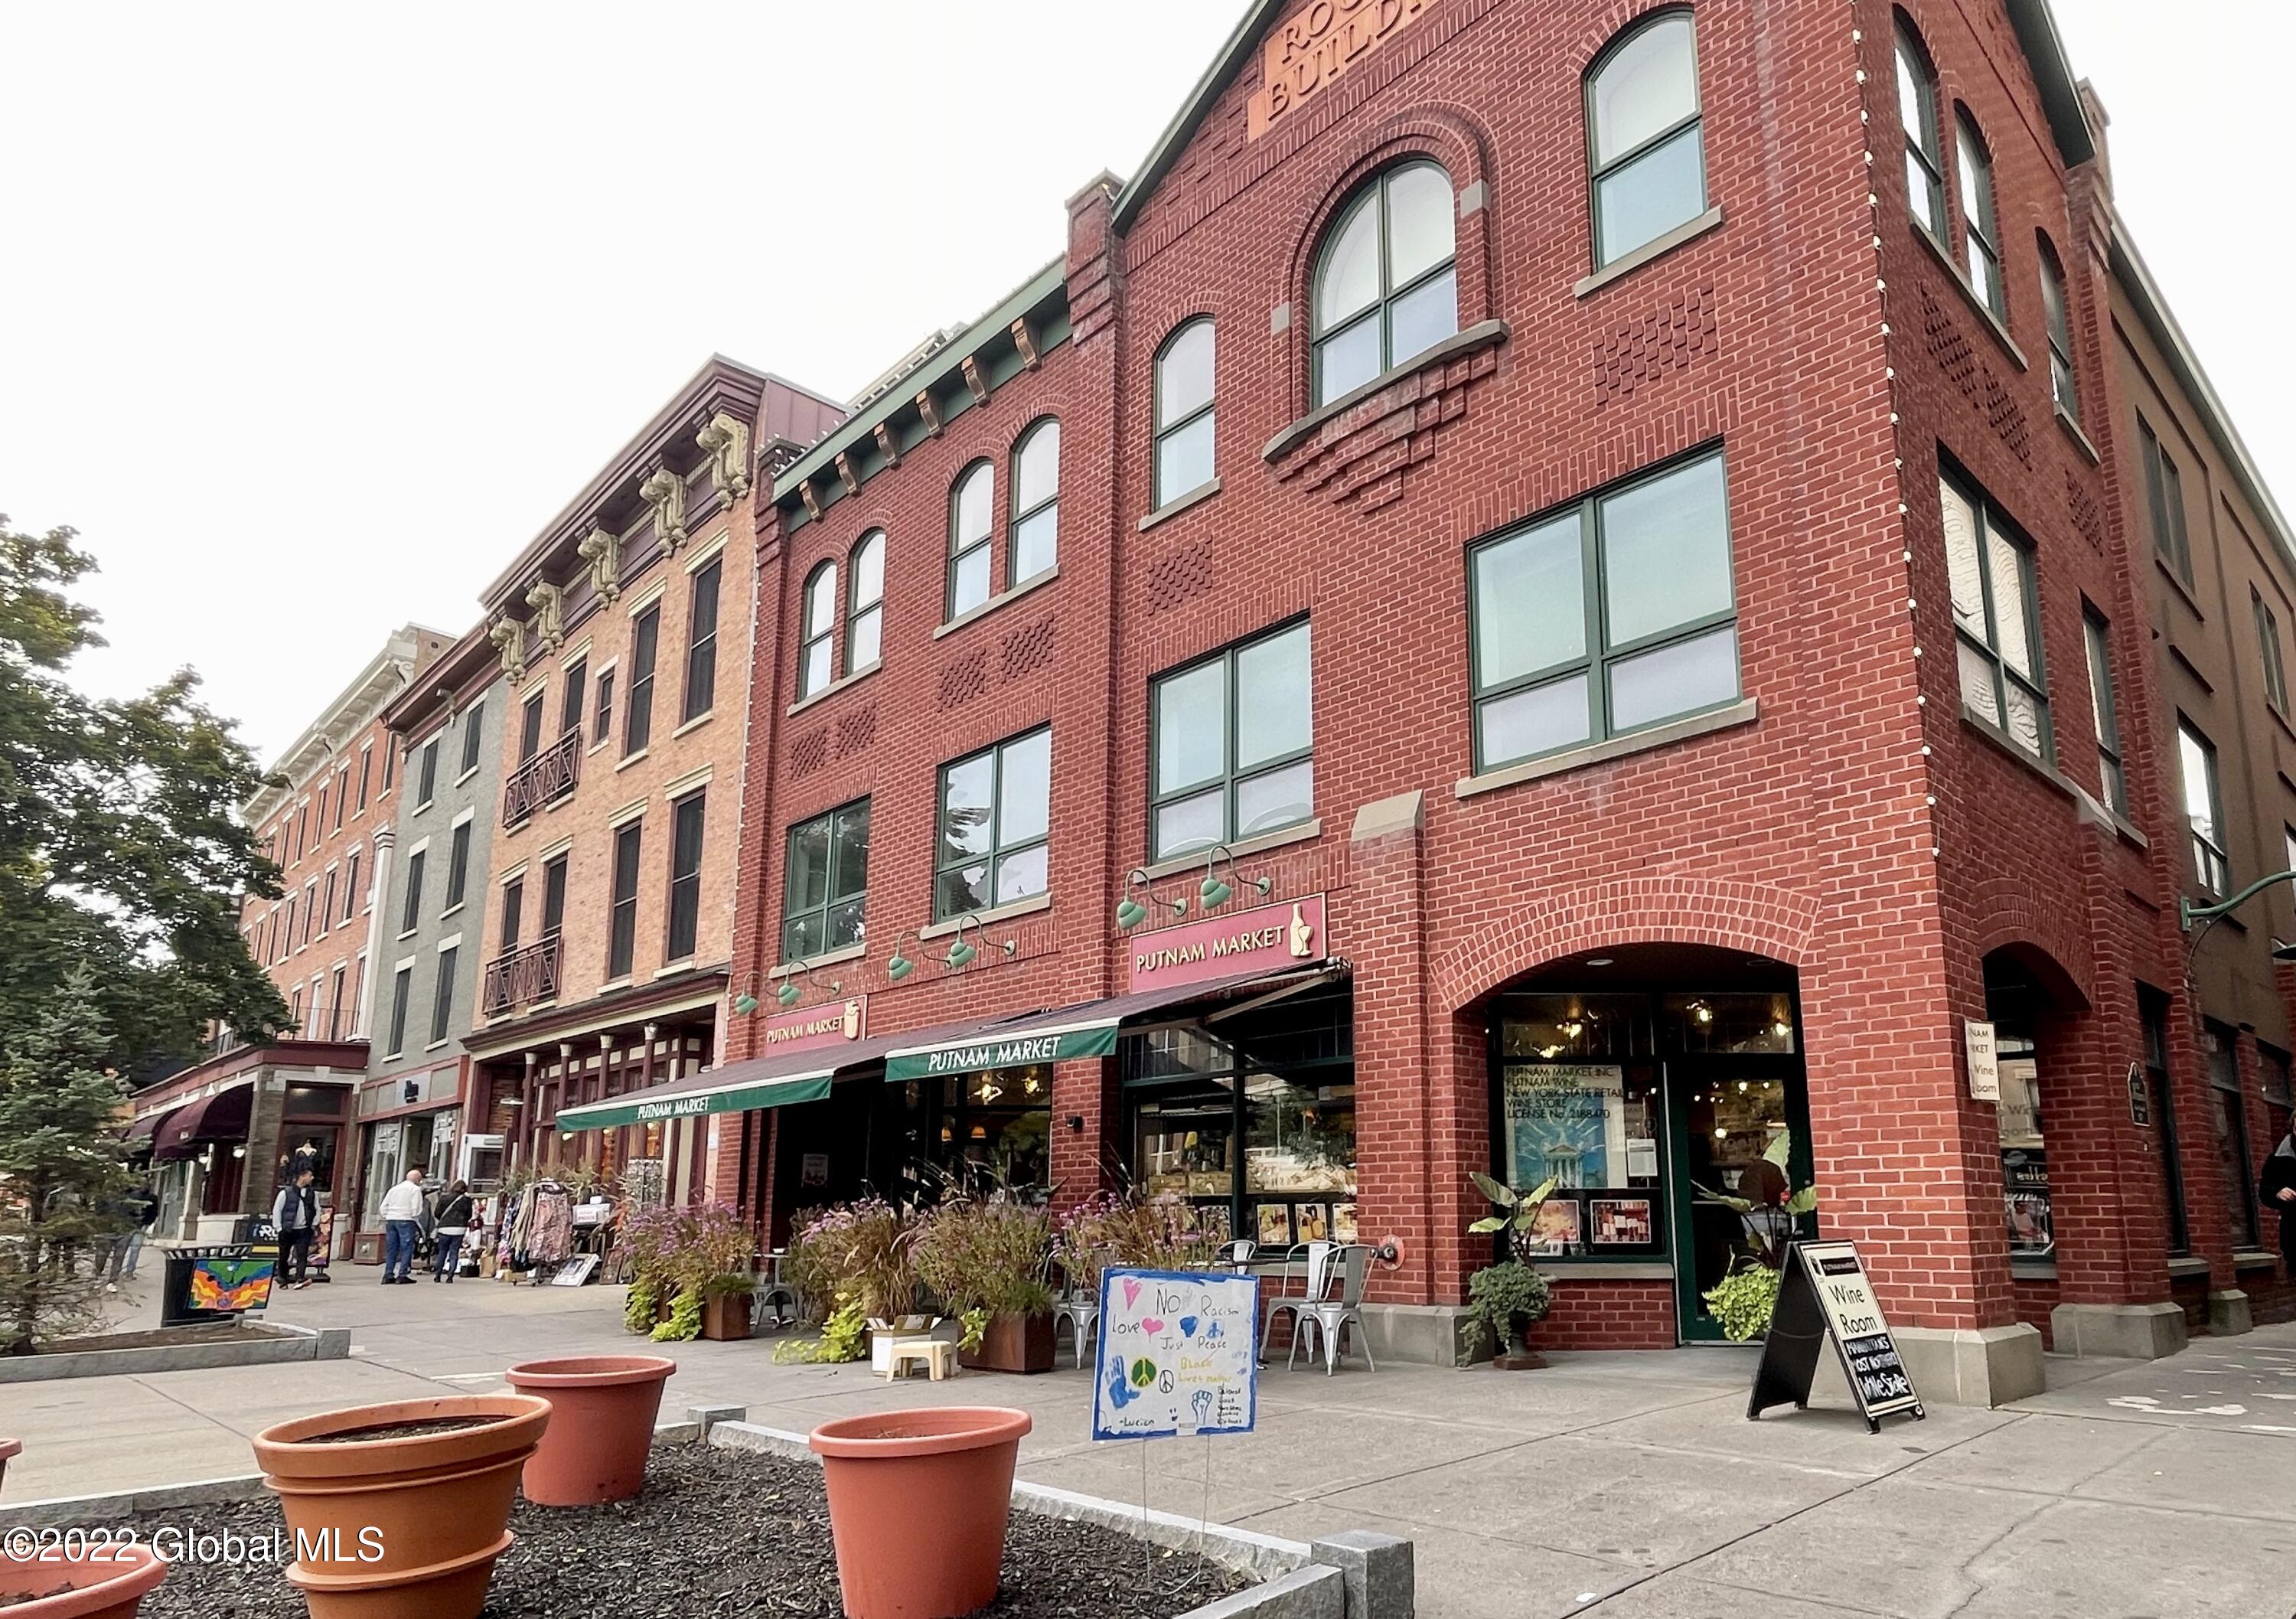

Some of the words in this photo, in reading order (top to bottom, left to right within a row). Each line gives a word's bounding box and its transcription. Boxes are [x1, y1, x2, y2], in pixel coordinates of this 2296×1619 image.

[1136, 942, 1206, 973] PUTNAM
[1212, 925, 1285, 958] MARKET
[766, 1023, 804, 1044] PUTNAM
[806, 1017, 844, 1036] MARKET
[927, 1045, 990, 1072] PUTNAM
[995, 1036, 1063, 1063] MARKET
[1505, 1066, 1550, 1076] PUTNAM
[1552, 1066, 1592, 1076] MARKET
[1505, 1077, 1550, 1087] PUTNAM
[1552, 1077, 1580, 1087] WINE
[1506, 1088, 1531, 1098] NEW
[1533, 1088, 1562, 1098] YORK
[1564, 1088, 1592, 1098] STATE
[1506, 1098, 1533, 1108] WINE
[1535, 1098, 1567, 1108] STORE
[637, 1102, 672, 1120] PUTNAM
[673, 1095, 710, 1115] MARKET
[1507, 1109, 1546, 1119] LICENSE
[1200, 1294, 1240, 1317] Racism
[1828, 1284, 1865, 1306] Wine
[1113, 1314, 1141, 1335] Love
[1839, 1313, 1878, 1335] Room
[1159, 1337, 1183, 1350] Just
[1197, 1336, 1228, 1350] Peace
